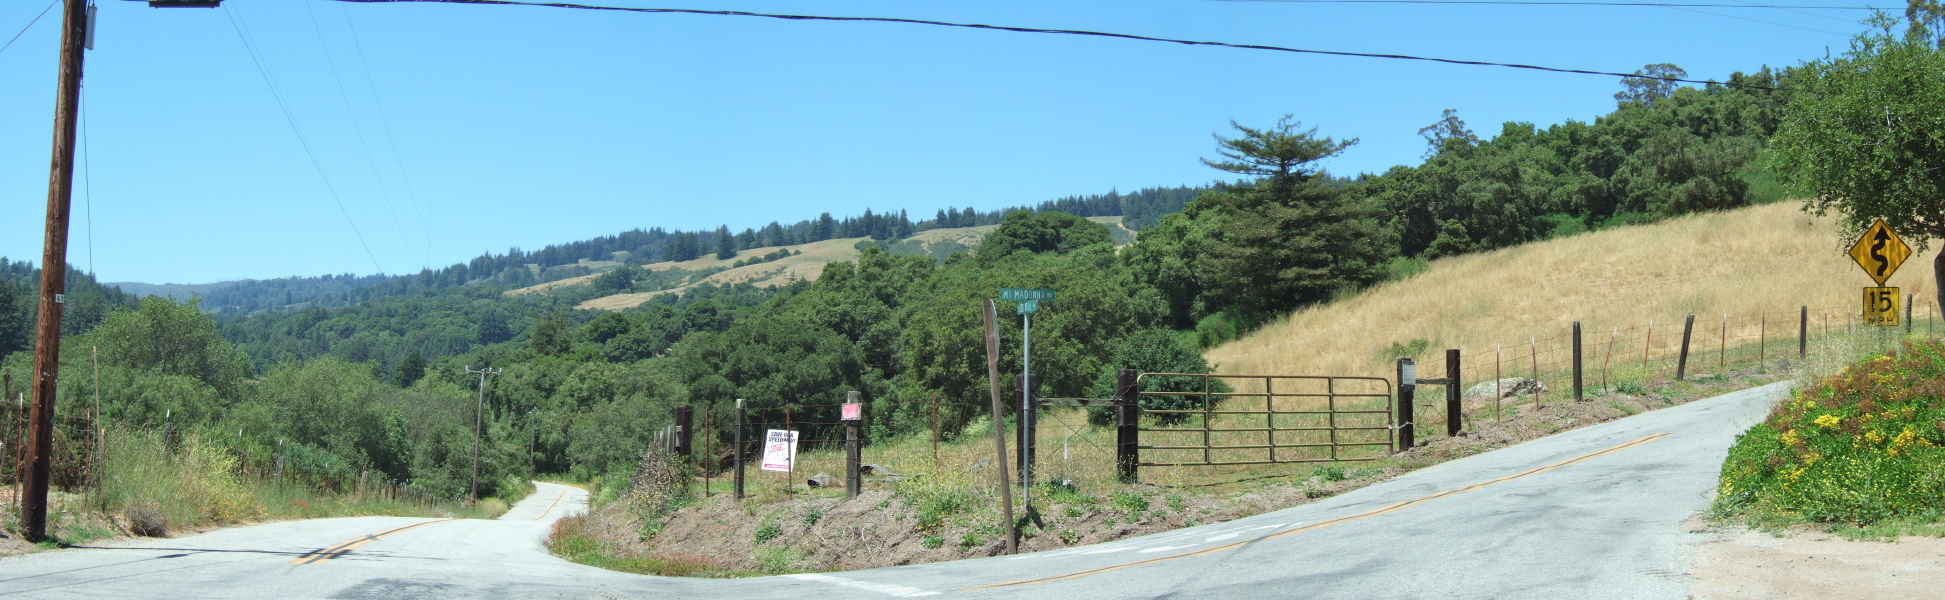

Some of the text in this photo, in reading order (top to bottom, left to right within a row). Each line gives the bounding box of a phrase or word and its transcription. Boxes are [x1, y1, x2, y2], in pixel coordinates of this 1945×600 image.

[1003, 290, 1012, 299] MT
[1014, 290, 1045, 300] MADONNA
[1869, 291, 1892, 312] 15
[1868, 316, 1894, 325] MPH
